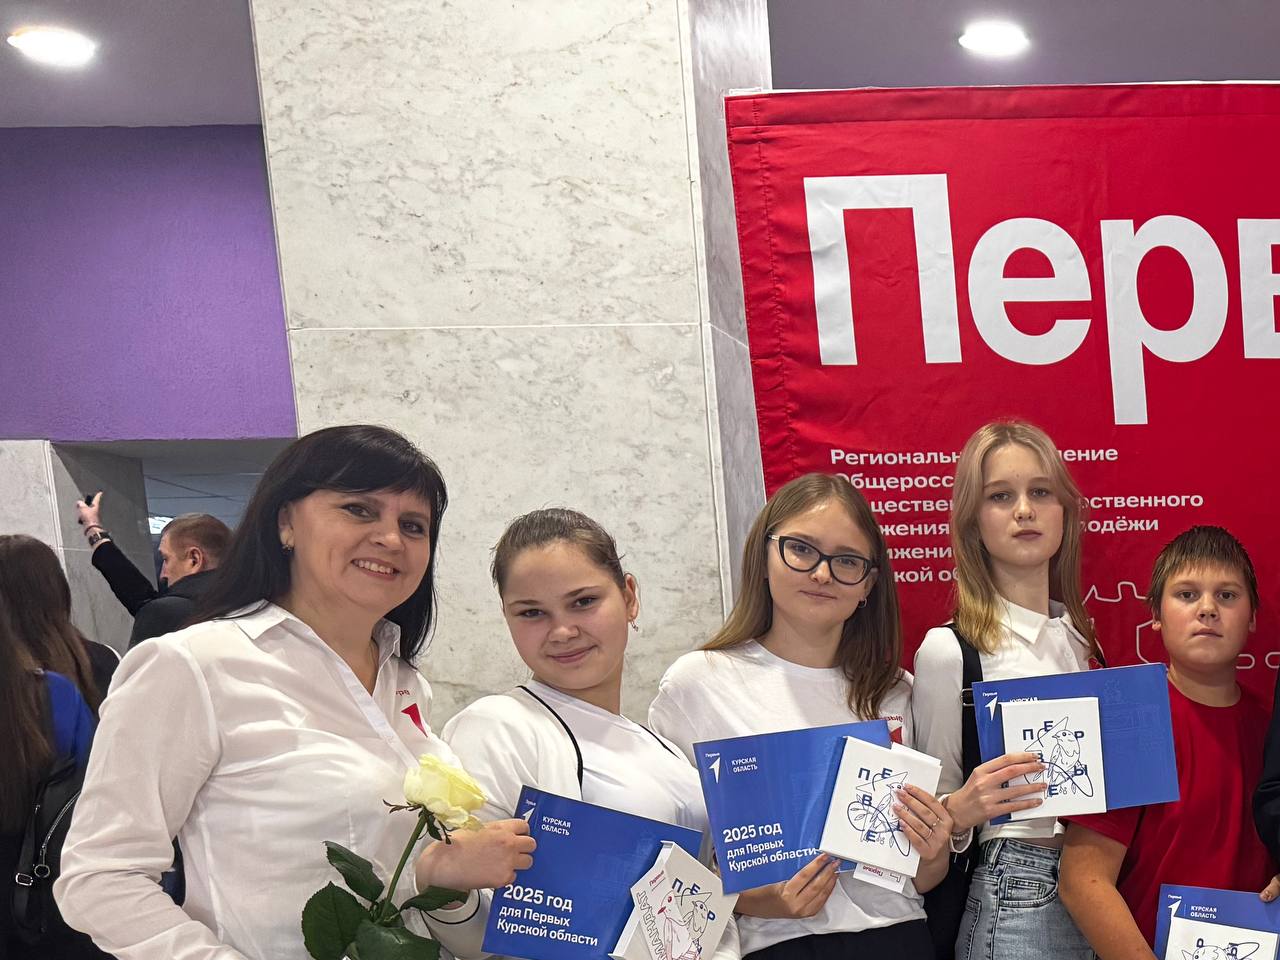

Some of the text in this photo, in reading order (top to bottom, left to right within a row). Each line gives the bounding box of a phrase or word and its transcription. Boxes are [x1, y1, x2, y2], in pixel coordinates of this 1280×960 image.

[830, 449, 961, 465] Региональн
[879, 516, 1159, 536] жения одёжи
[731, 757, 757, 766] КУРСКАЯ
[541, 824, 570, 836] ОБЛАСТЬ
[542, 816, 571, 828] КУРСКАЯ
[723, 823, 782, 843] 2025 год
[727, 840, 784, 859] для Первых
[729, 848, 817, 872] Курской области
[503, 884, 573, 913] 2025 год
[499, 906, 571, 927] для Первых
[1191, 905, 1217, 913] КУРСКАЯ
[497, 918, 598, 946] Курской области
